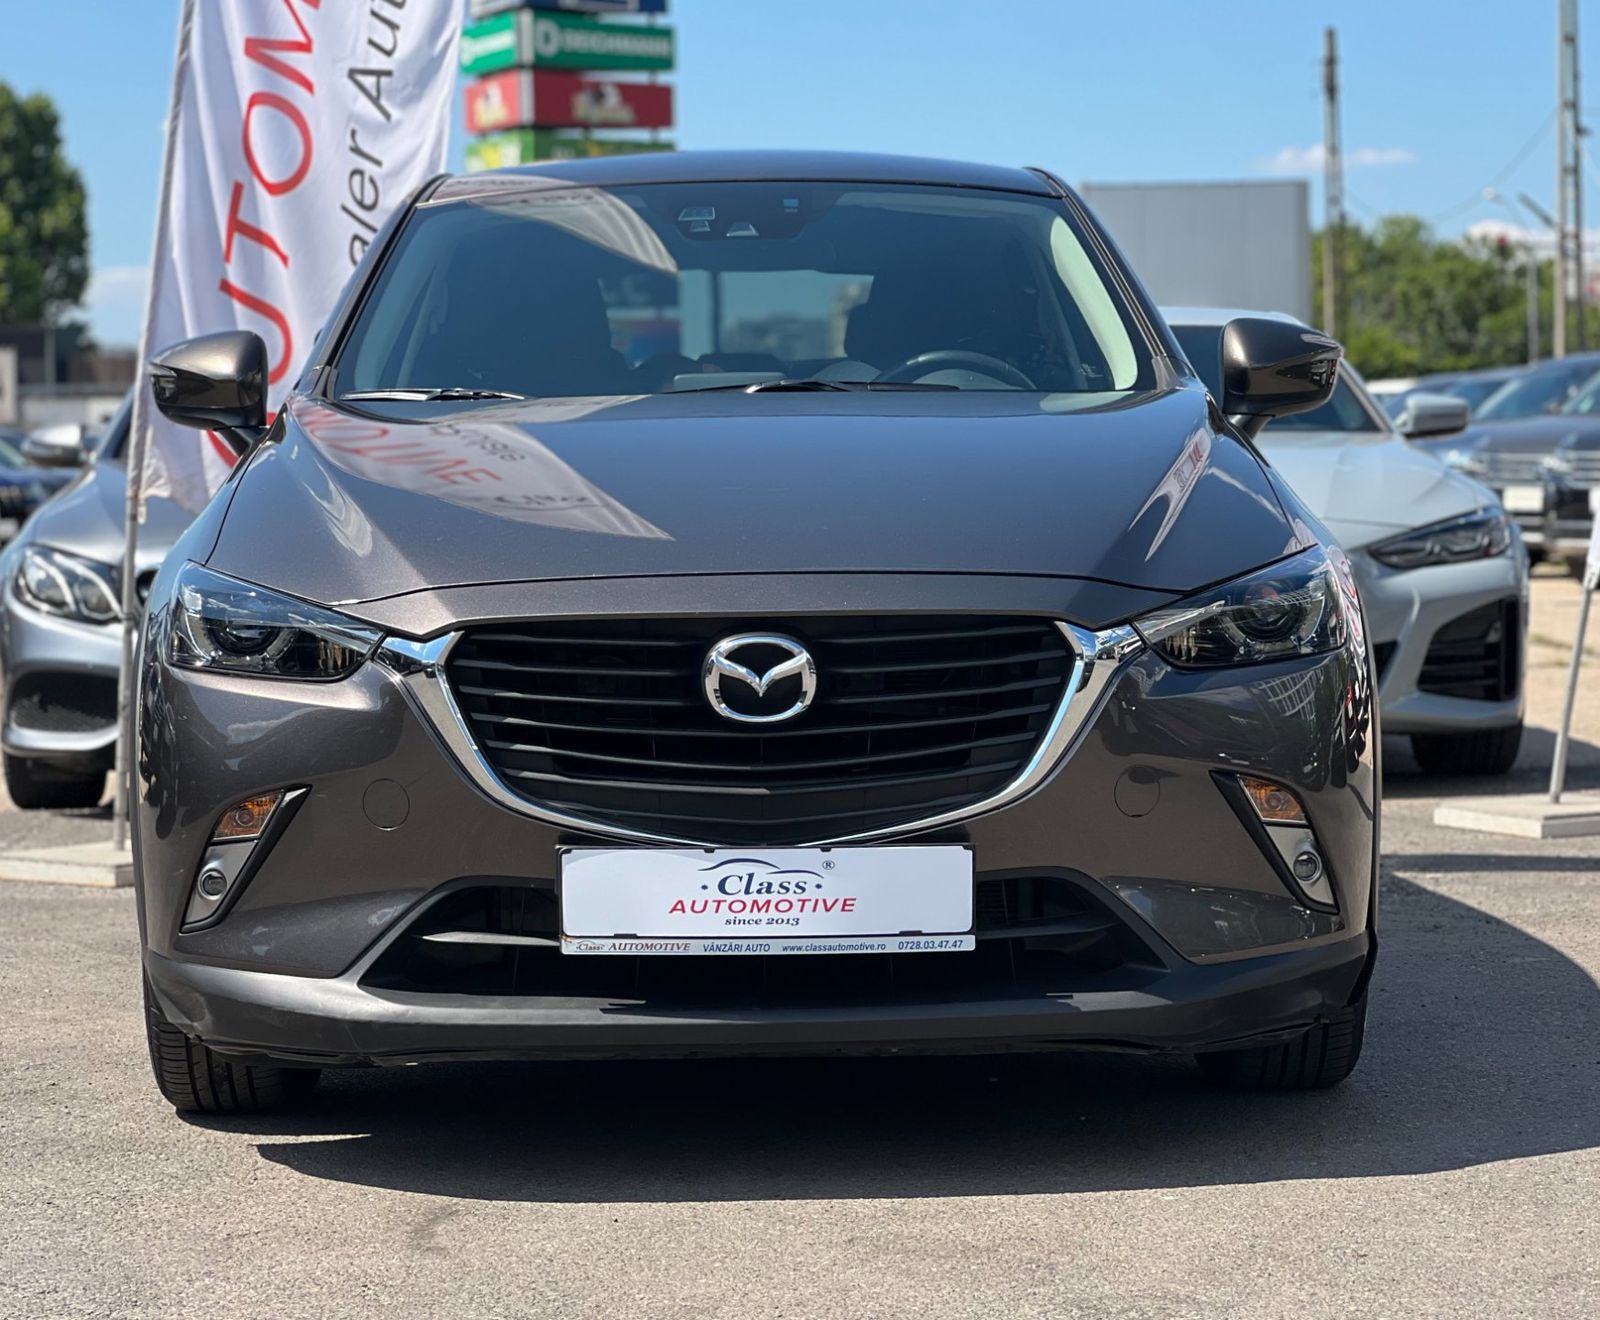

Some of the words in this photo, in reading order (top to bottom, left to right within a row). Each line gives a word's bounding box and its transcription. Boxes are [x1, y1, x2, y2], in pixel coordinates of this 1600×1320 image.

[717, 872, 807, 896] Class
[668, 897, 857, 914] AUTOMOTIVE
[724, 916, 763, 926] since
[765, 916, 800, 927] 2013
[608, 942, 692, 951] AUTOMOTIVE
[745, 943, 771, 953] AUTO
[782, 942, 887, 953] www.classautomotive.ro
[898, 940, 964, 950] 0728.03.47.47
